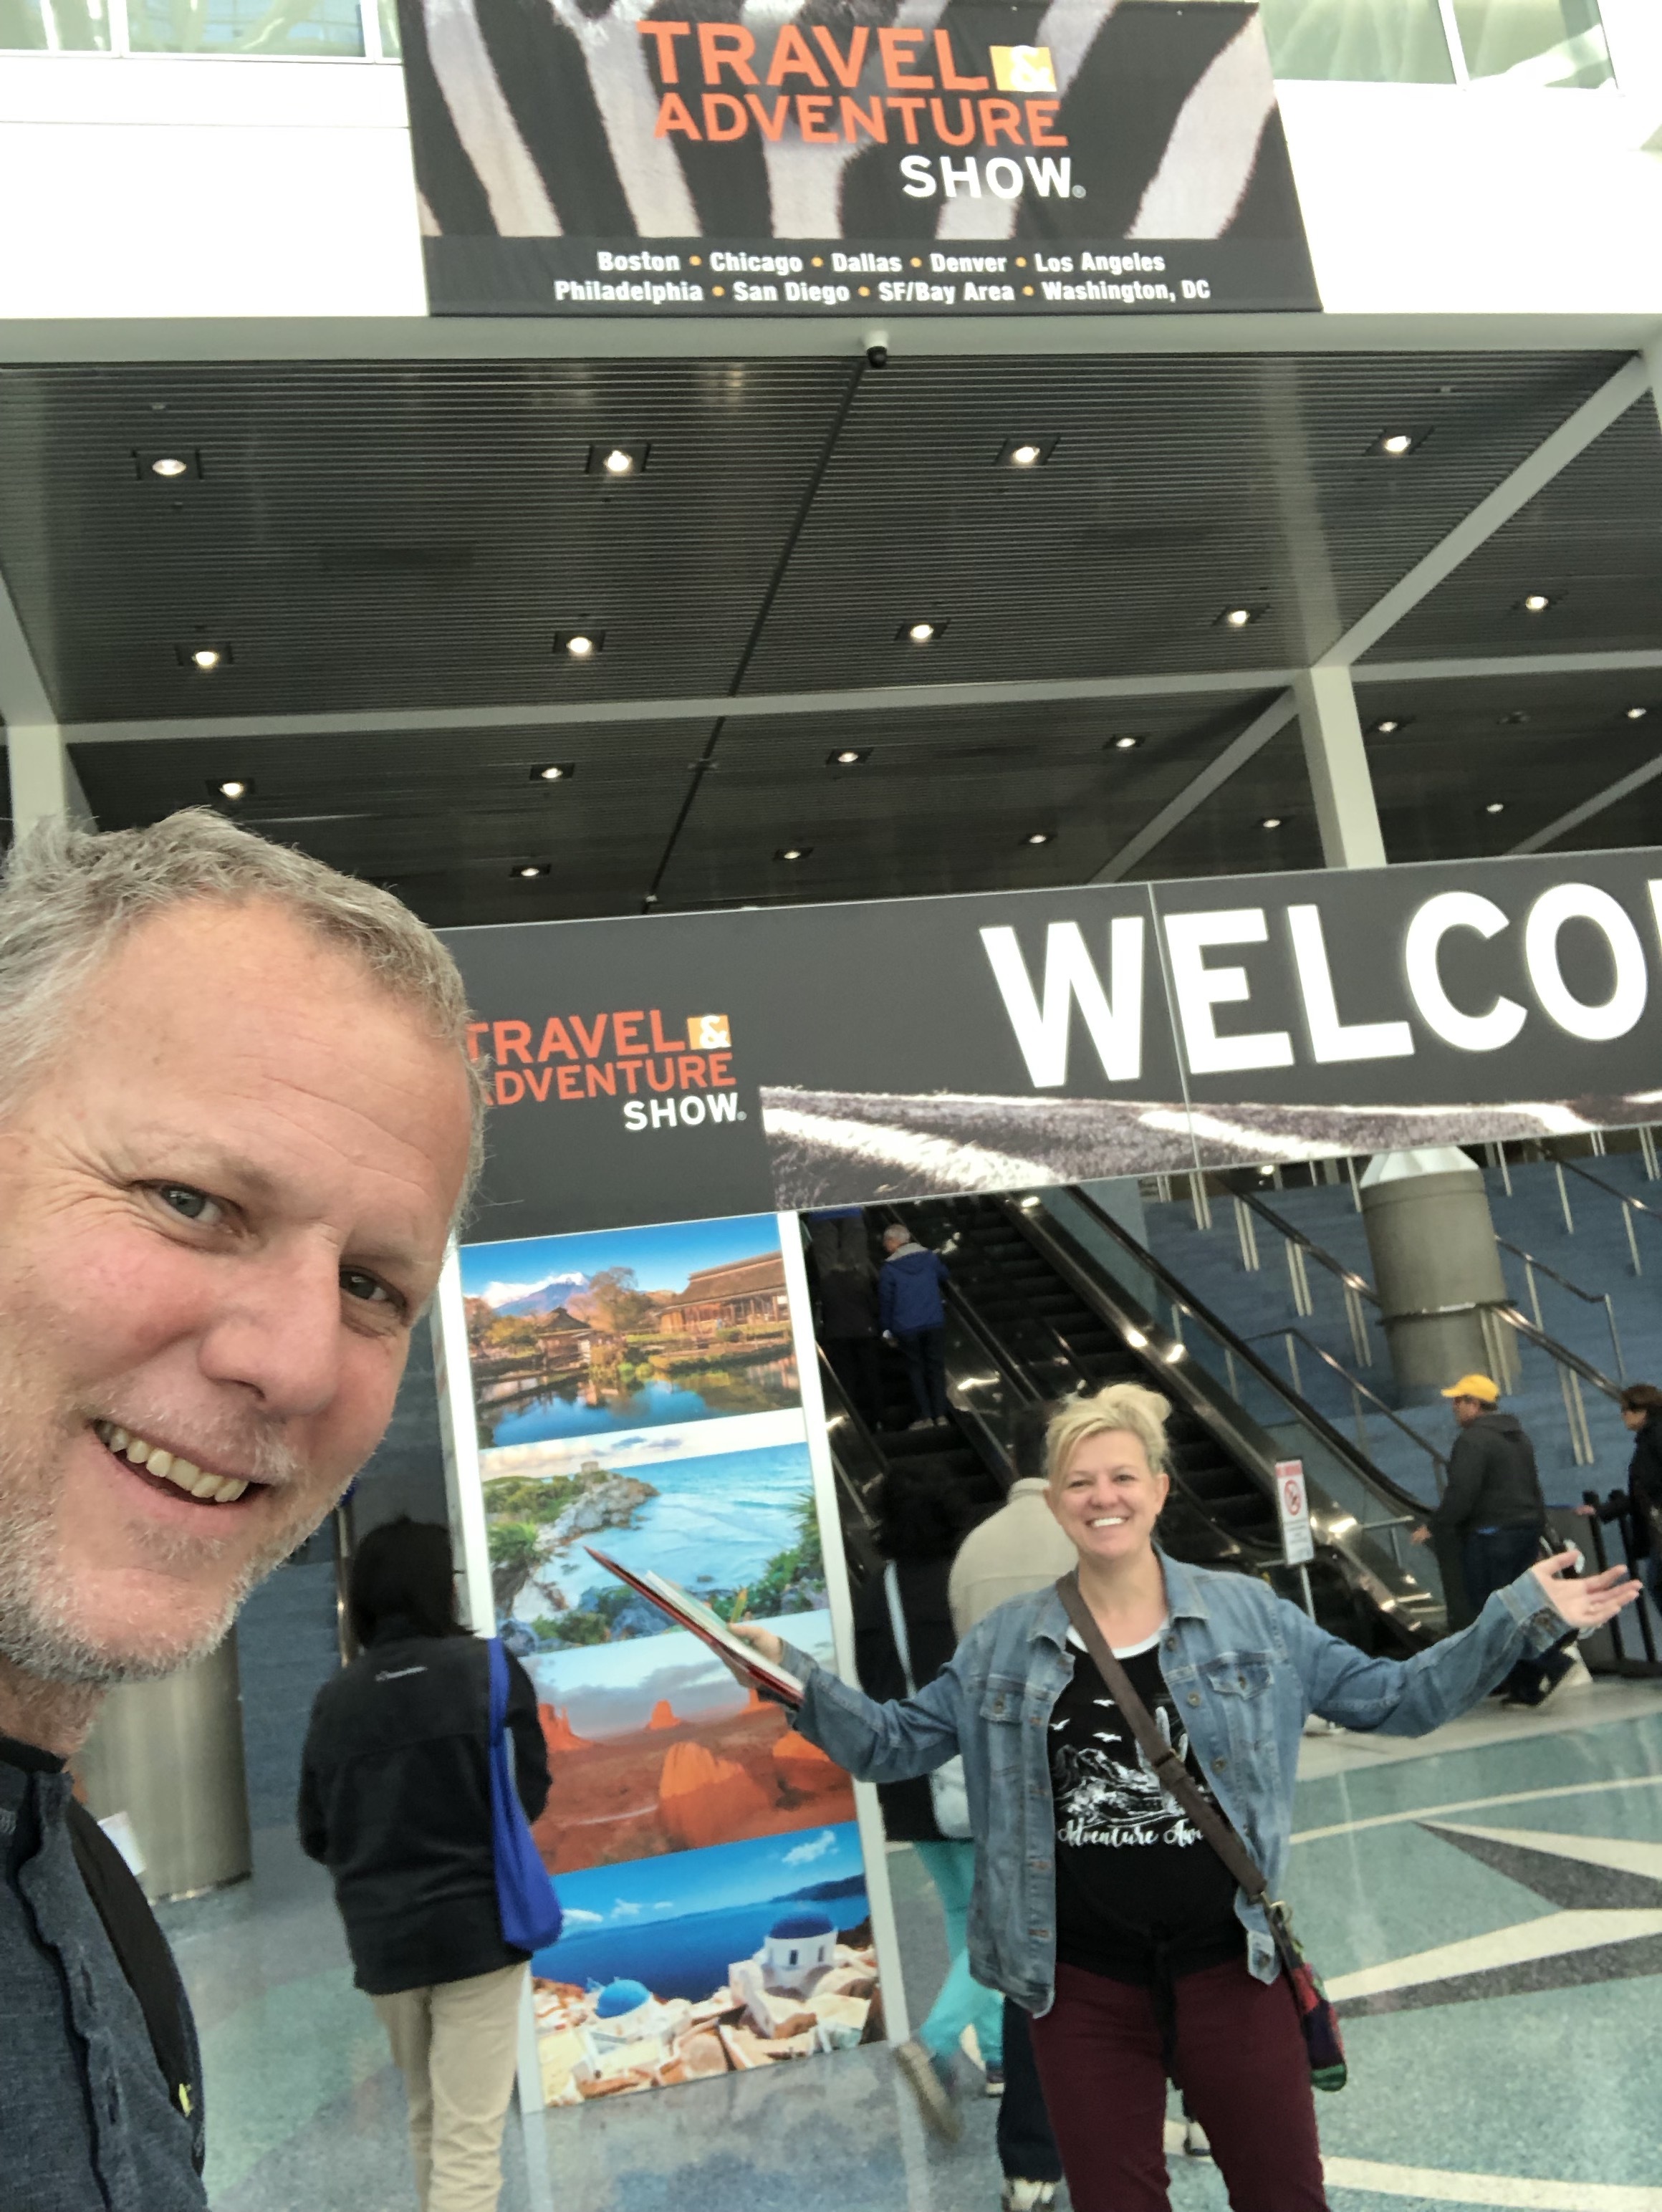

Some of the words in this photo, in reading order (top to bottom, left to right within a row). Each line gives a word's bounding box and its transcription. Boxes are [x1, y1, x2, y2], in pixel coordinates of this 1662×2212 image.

[636, 21, 989, 90] TRAVEL
[653, 93, 1068, 147] ADVENTURE
[597, 251, 681, 271] Boston
[709, 252, 803, 276] Chicago
[830, 253, 903, 272] Dallas
[930, 253, 1007, 272] Denver
[1034, 253, 1074, 272] Los
[1081, 252, 1166, 275] Angeles
[554, 280, 704, 304] Philadelphia
[733, 282, 778, 302] San
[784, 282, 851, 304] Diego
[878, 282, 956, 304] SF/Bay
[963, 282, 1016, 302] Area
[1041, 281, 1176, 304] Washington,
[1181, 279, 1211, 299] DC
[979, 880, 1662, 1088] WELCO
[466, 1009, 686, 1066] TRAVEL
[484, 1052, 736, 1107] DVENTURE
[1058, 1817, 1158, 1847] Adventure
